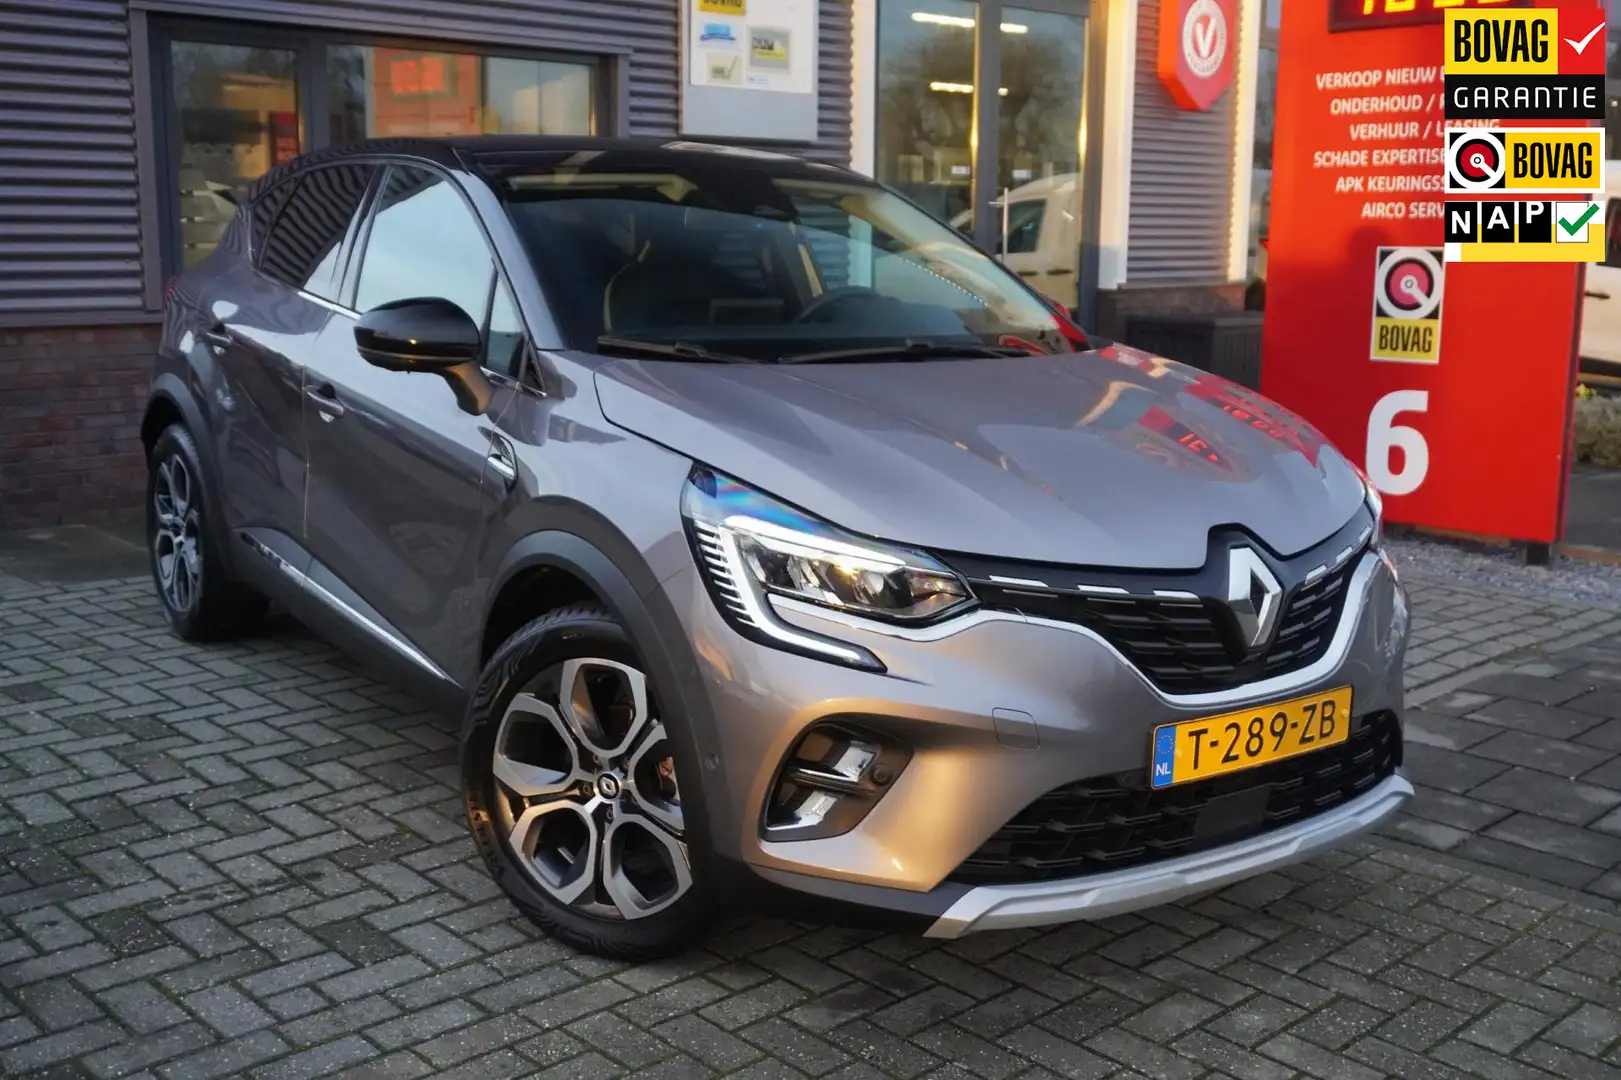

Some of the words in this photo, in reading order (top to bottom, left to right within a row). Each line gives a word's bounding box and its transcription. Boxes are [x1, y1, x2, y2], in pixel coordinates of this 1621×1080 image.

[1316, 69, 1382, 90] VERKOOP
[1385, 66, 1436, 85] NIEUW
[1330, 95, 1423, 115] ONDERHOUD
[1350, 121, 1419, 140] VERHUUR
[1313, 150, 1369, 168] SCHADE
[1335, 176, 1364, 194] APK
[1361, 202, 1406, 219] AIRCO
[1379, 324, 1432, 353] BOVAG
[1365, 390, 1429, 495] 6
[1188, 700, 1336, 770] T-289-ZB
[1155, 763, 1171, 777] NL
